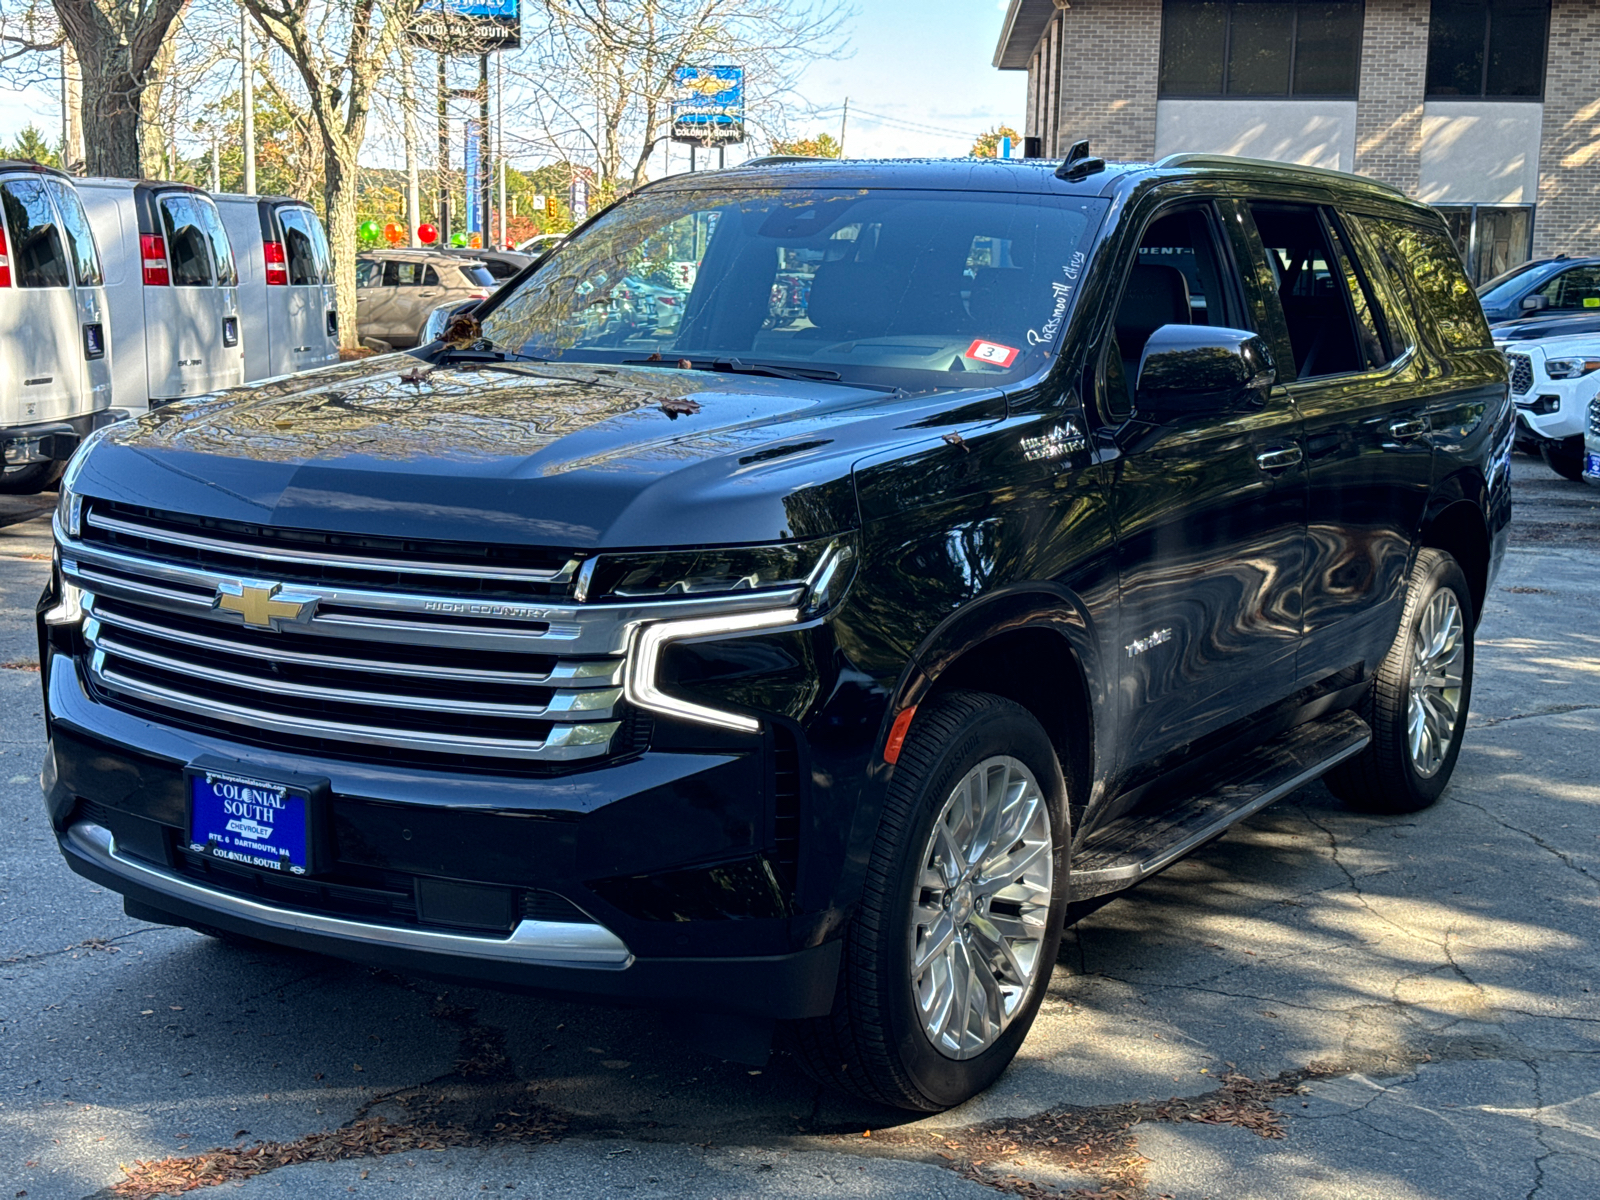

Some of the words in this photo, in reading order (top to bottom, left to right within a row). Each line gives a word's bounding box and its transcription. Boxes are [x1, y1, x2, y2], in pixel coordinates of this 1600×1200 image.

[474, 26, 509, 38] SOUTH
[982, 346, 996, 358] 3
[424, 601, 465, 613] HIGH
[469, 604, 552, 619] COUNTRY
[224, 800, 275, 824] SOUTH
[230, 822, 269, 836] CHEVROLET
[224, 836, 230, 844] 6
[279, 848, 290, 857] MA
[213, 848, 253, 864] COLONIAL
[253, 856, 281, 870] SOUTH
